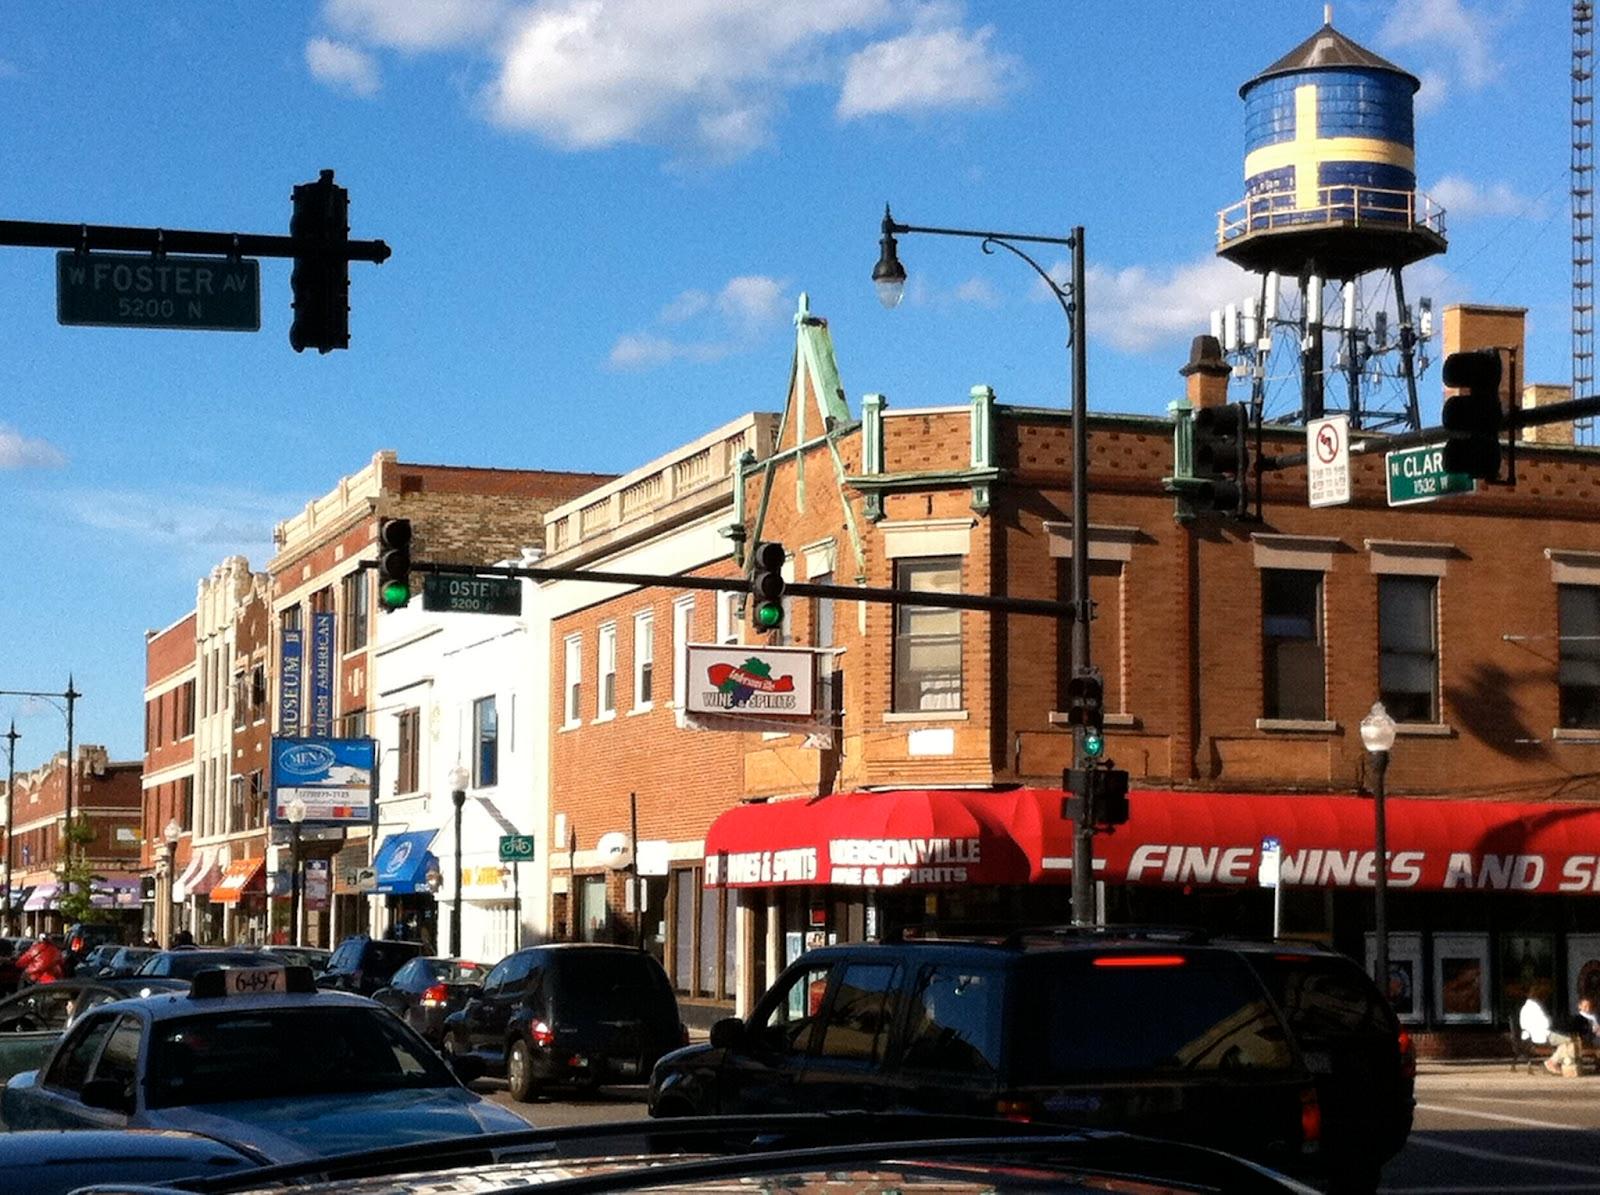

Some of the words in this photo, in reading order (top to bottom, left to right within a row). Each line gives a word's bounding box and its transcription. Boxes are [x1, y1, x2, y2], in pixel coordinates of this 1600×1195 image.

[70, 267, 86, 286] W
[94, 263, 214, 295] FOSTER
[223, 273, 248, 292] AV
[118, 298, 175, 318] 5200
[188, 302, 202, 319] N
[1391, 462, 1399, 477] N
[1403, 452, 1444, 478] CLAR
[450, 597, 480, 610] 5200
[317, 615, 330, 689] AMERICAN
[282, 656, 300, 738] MUSEUM
[702, 692, 734, 707] WINE
[748, 694, 797, 710] SPIRITS
[863, 866, 880, 885] &
[882, 866, 968, 886] SPIRITS
[1125, 844, 1254, 884] FINE
[1443, 852, 1545, 890] AND
[1558, 855, 1600, 893] S
[235, 971, 279, 992] 6497
